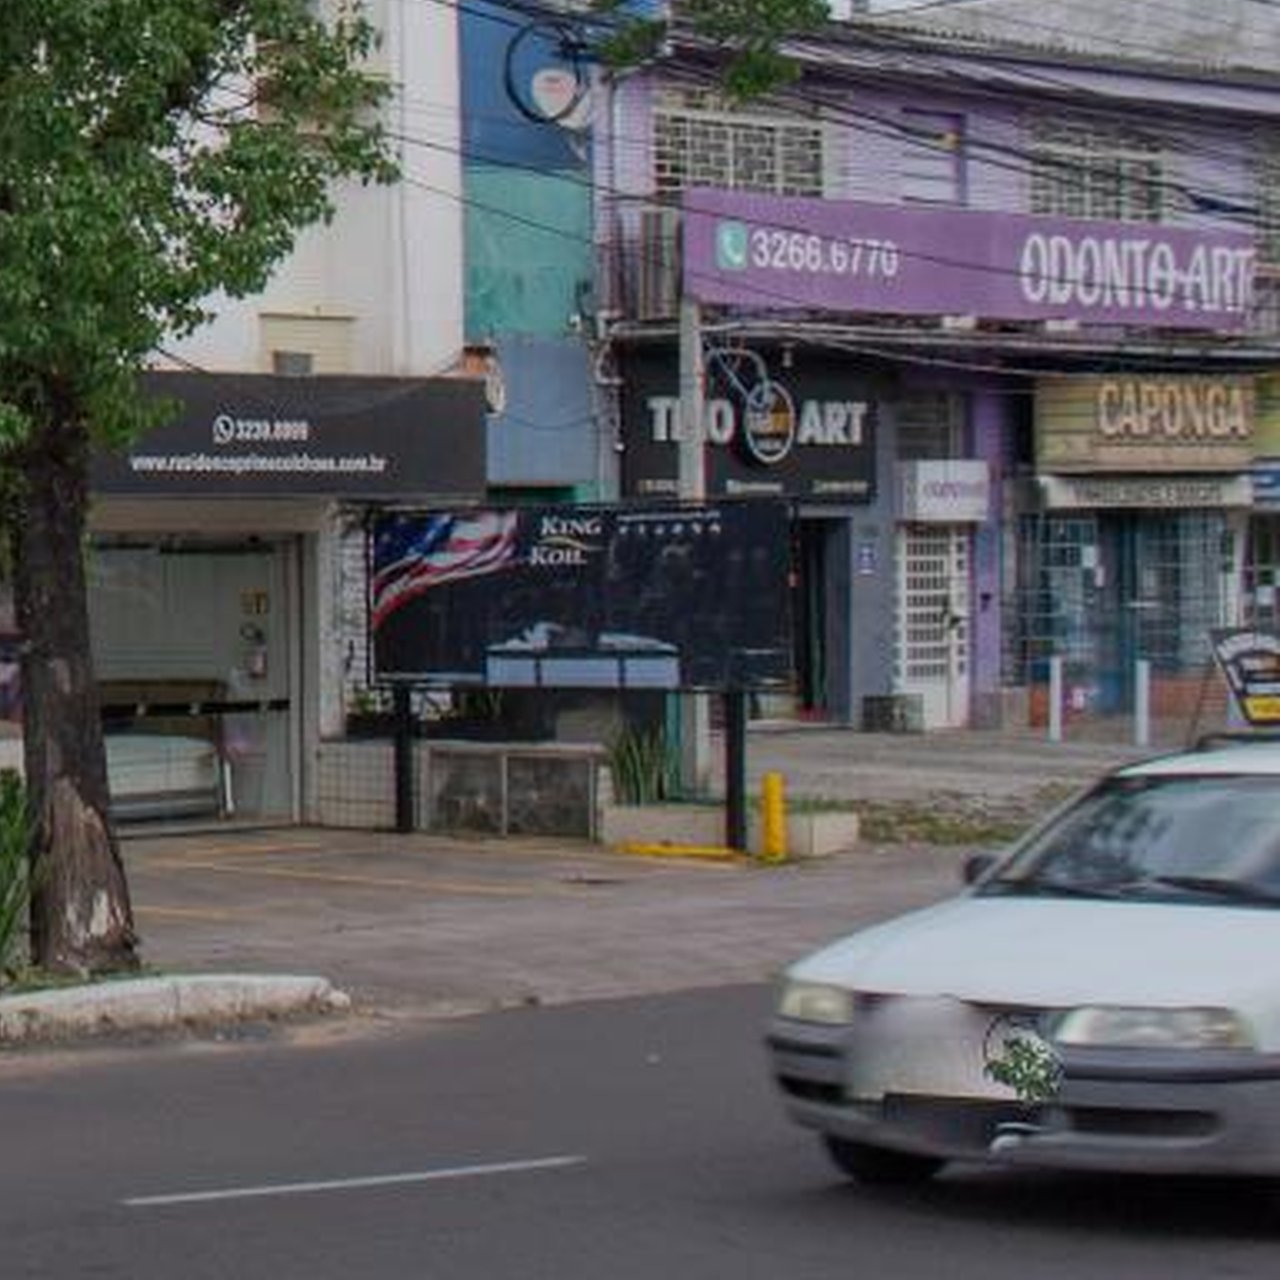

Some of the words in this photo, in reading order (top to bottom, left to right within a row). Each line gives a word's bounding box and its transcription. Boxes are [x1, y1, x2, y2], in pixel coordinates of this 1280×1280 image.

[1021, 234, 1175, 308] ODONTO
[797, 400, 867, 445] ART
[1097, 380, 1251, 437] CAPONGA
[542, 517, 602, 535] KING
